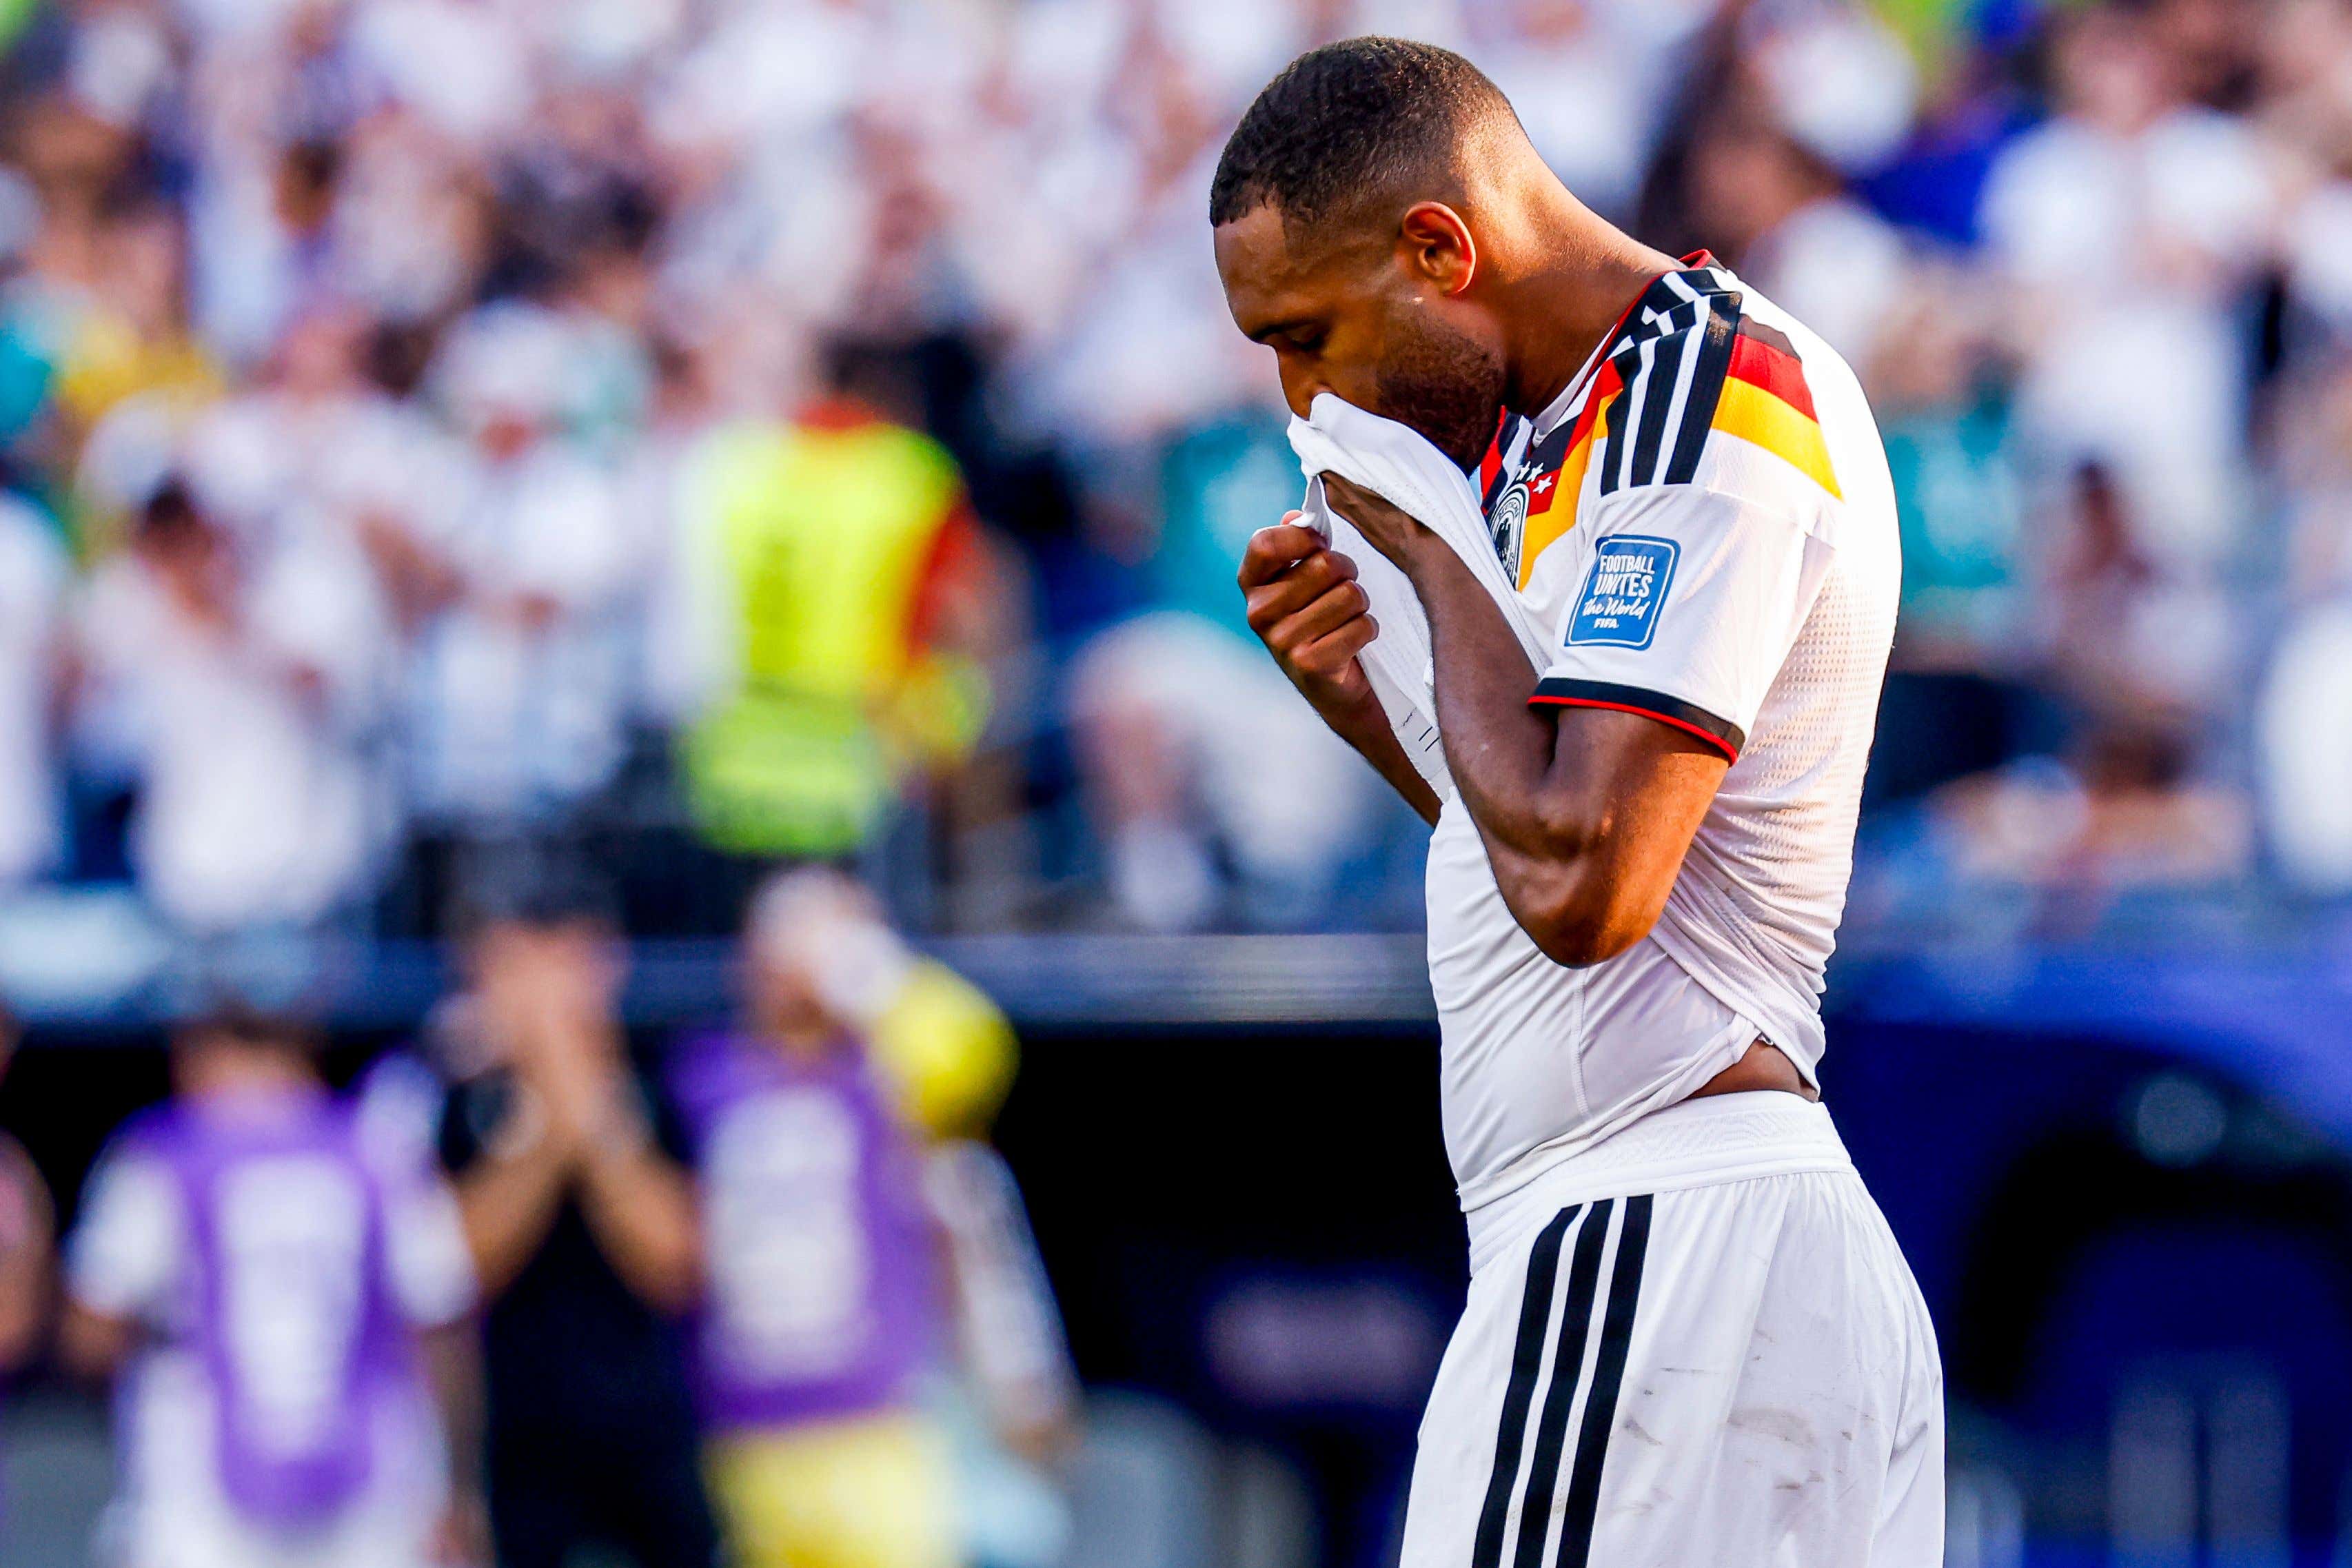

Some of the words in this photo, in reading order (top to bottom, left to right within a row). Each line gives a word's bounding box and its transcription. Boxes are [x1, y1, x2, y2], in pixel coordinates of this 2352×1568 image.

[1599, 555, 1654, 574] FOOTBALL
[1594, 573, 1653, 598] UNITES
[1583, 596, 1604, 616] the
[1603, 597, 1651, 620] World
[1593, 618, 1618, 629] FIFA
